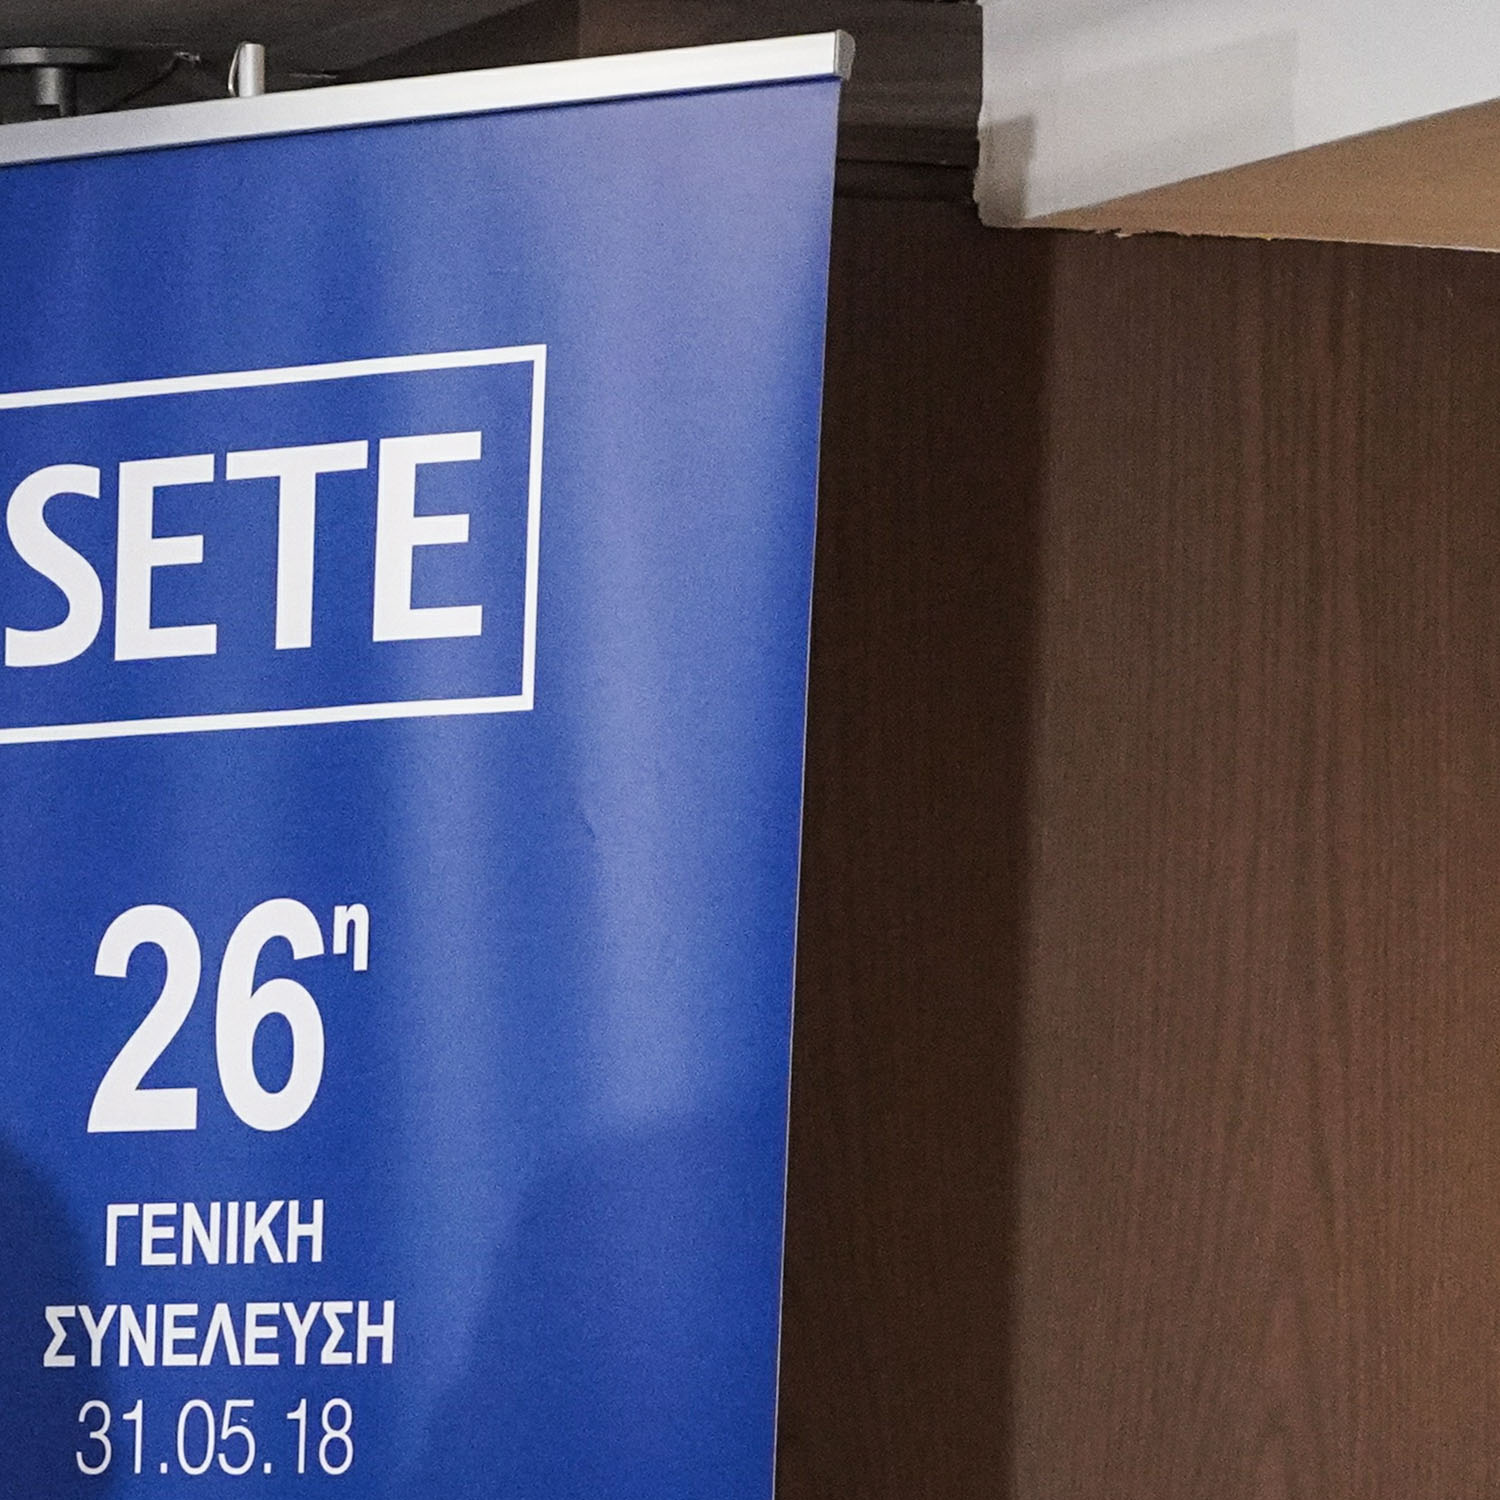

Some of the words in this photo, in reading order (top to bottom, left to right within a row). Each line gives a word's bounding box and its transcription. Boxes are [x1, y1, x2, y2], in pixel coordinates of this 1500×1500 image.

[4, 431, 484, 668] SETE
[105, 1199, 324, 1266] ΓΕΝΙΚΗ
[43, 1300, 395, 1367] ΣΥΝΕΛΕΥΣΗ
[75, 1398, 354, 1475] 31.05.18
